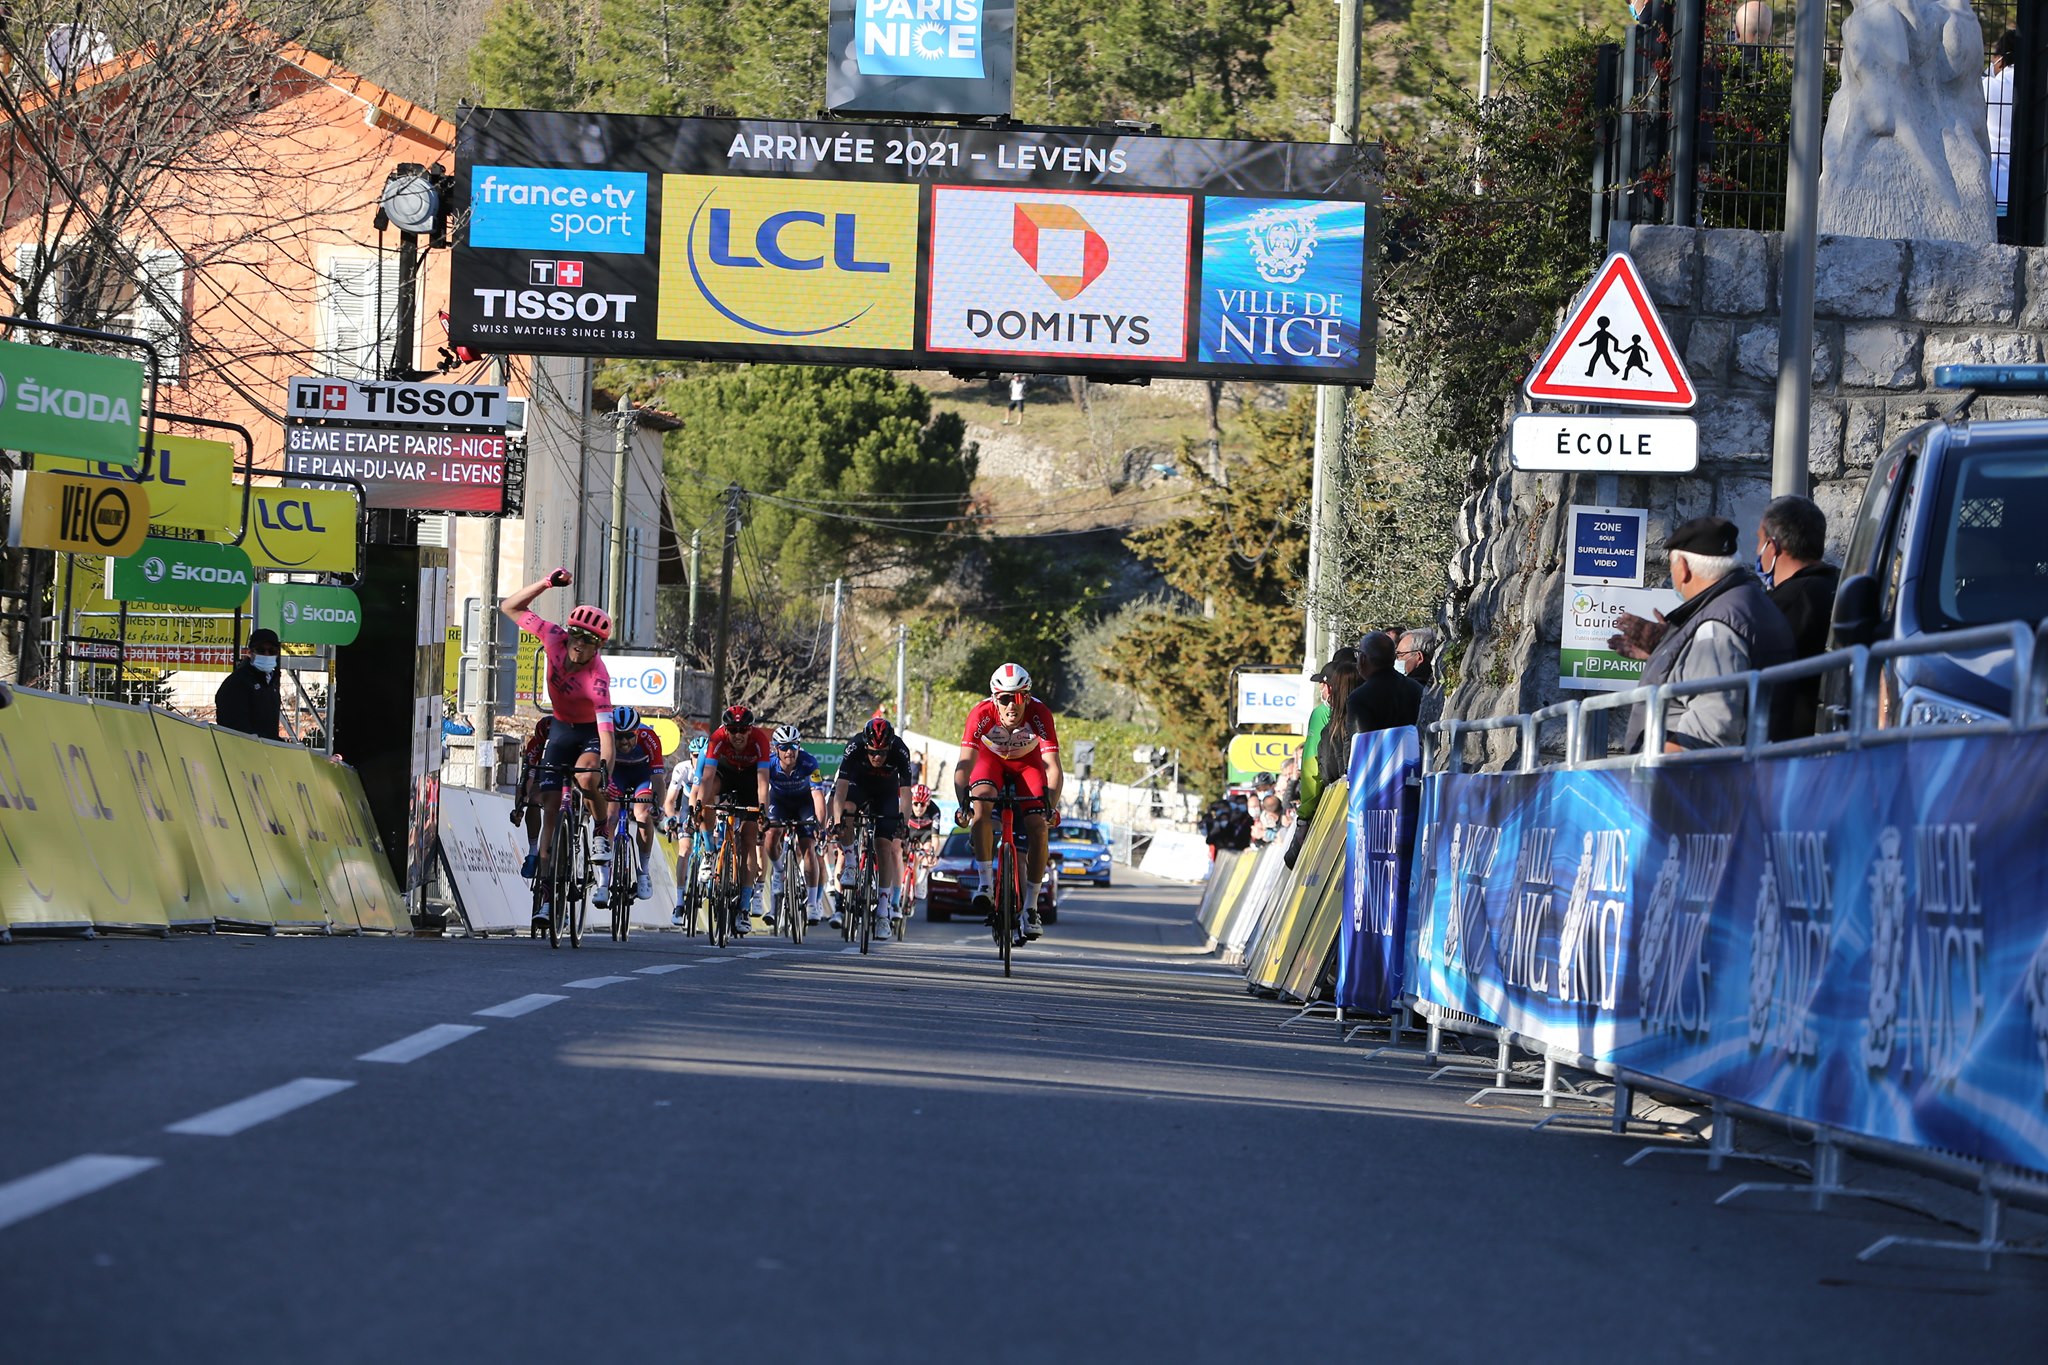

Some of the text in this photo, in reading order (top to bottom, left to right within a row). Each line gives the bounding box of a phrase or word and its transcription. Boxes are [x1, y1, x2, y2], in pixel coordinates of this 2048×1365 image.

[866, 0, 977, 22] PARIS
[864, 21, 977, 61] NICE
[727, 132, 875, 163] ARRIVÉE
[886, 139, 959, 166] 2021
[998, 144, 1127, 174] LEVENS
[550, 212, 632, 242] sport
[708, 208, 890, 273] LCL
[473, 288, 636, 323] TISSOT
[1216, 289, 1343, 317] VILLE DE
[472, 324, 636, 339] SWISS WATCHES SINCE 1853
[967, 309, 1150, 346] DOMITYS
[1216, 314, 1343, 358] NICE
[16, 377, 131, 426] ŠKODA
[359, 386, 500, 417] TISSOT
[345, 433, 400, 454] ETAPE
[405, 435, 503, 459] PARIS-NICE
[1557, 428, 1652, 455] ÉCOLE
[312, 457, 426, 481] PLAN-DU-VAR
[442, 463, 501, 484] LEVENS
[258, 498, 326, 533] LCL
[1593, 522, 1622, 532] ZONE
[1578, 546, 1635, 556] SURVEILLANCE
[1594, 559, 1618, 567] VIDEO
[171, 562, 247, 585] ŠKODA
[302, 605, 357, 623] ŠKODA
[1575, 615, 1619, 628] Laurie
[1601, 602, 1625, 614] Les
[1603, 660, 1646, 672] PARKI
[1255, 742, 1294, 756] LCL
[1365, 859, 1397, 937] NICE
